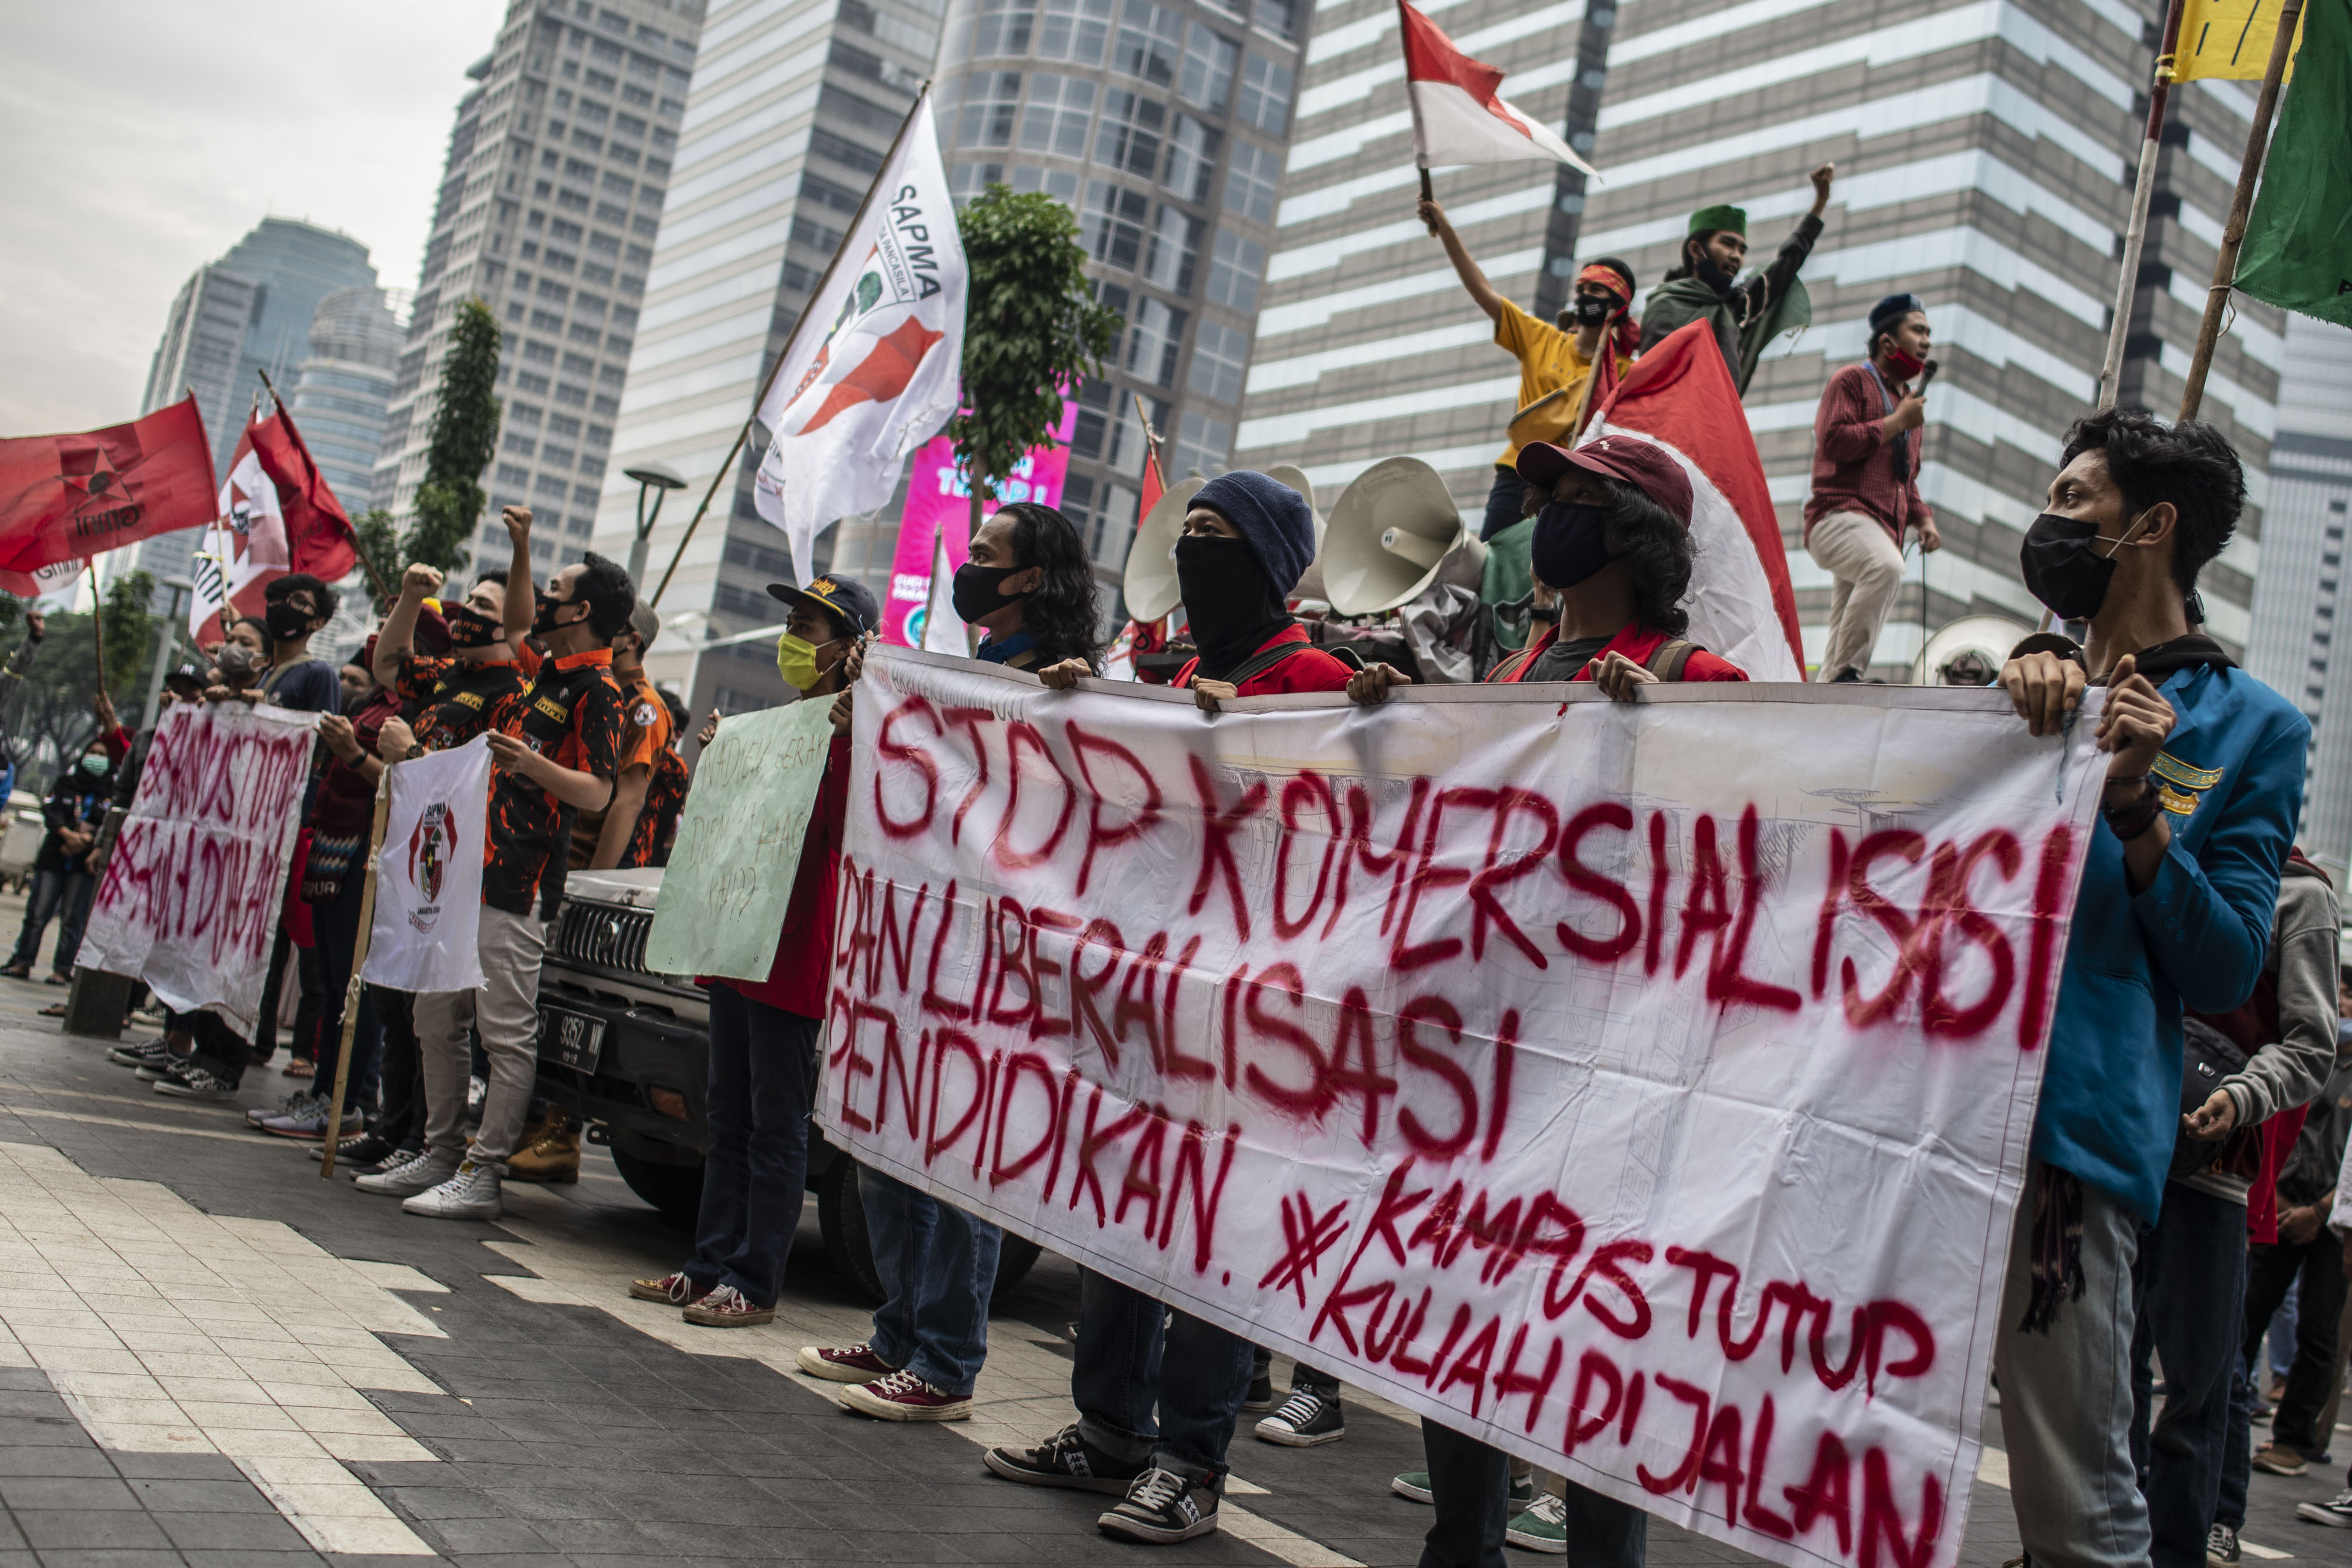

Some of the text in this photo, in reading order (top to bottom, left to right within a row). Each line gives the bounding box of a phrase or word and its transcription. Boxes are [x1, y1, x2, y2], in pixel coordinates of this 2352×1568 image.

[881, 240, 910, 297] PANCASILA
[891, 184, 942, 300] SAPMA
[873, 694, 1165, 898] STOP
[537, 1009, 549, 1039] B
[560, 1015, 584, 1051] 9352
[835, 854, 1519, 1163] DAN LIBERALISASI
